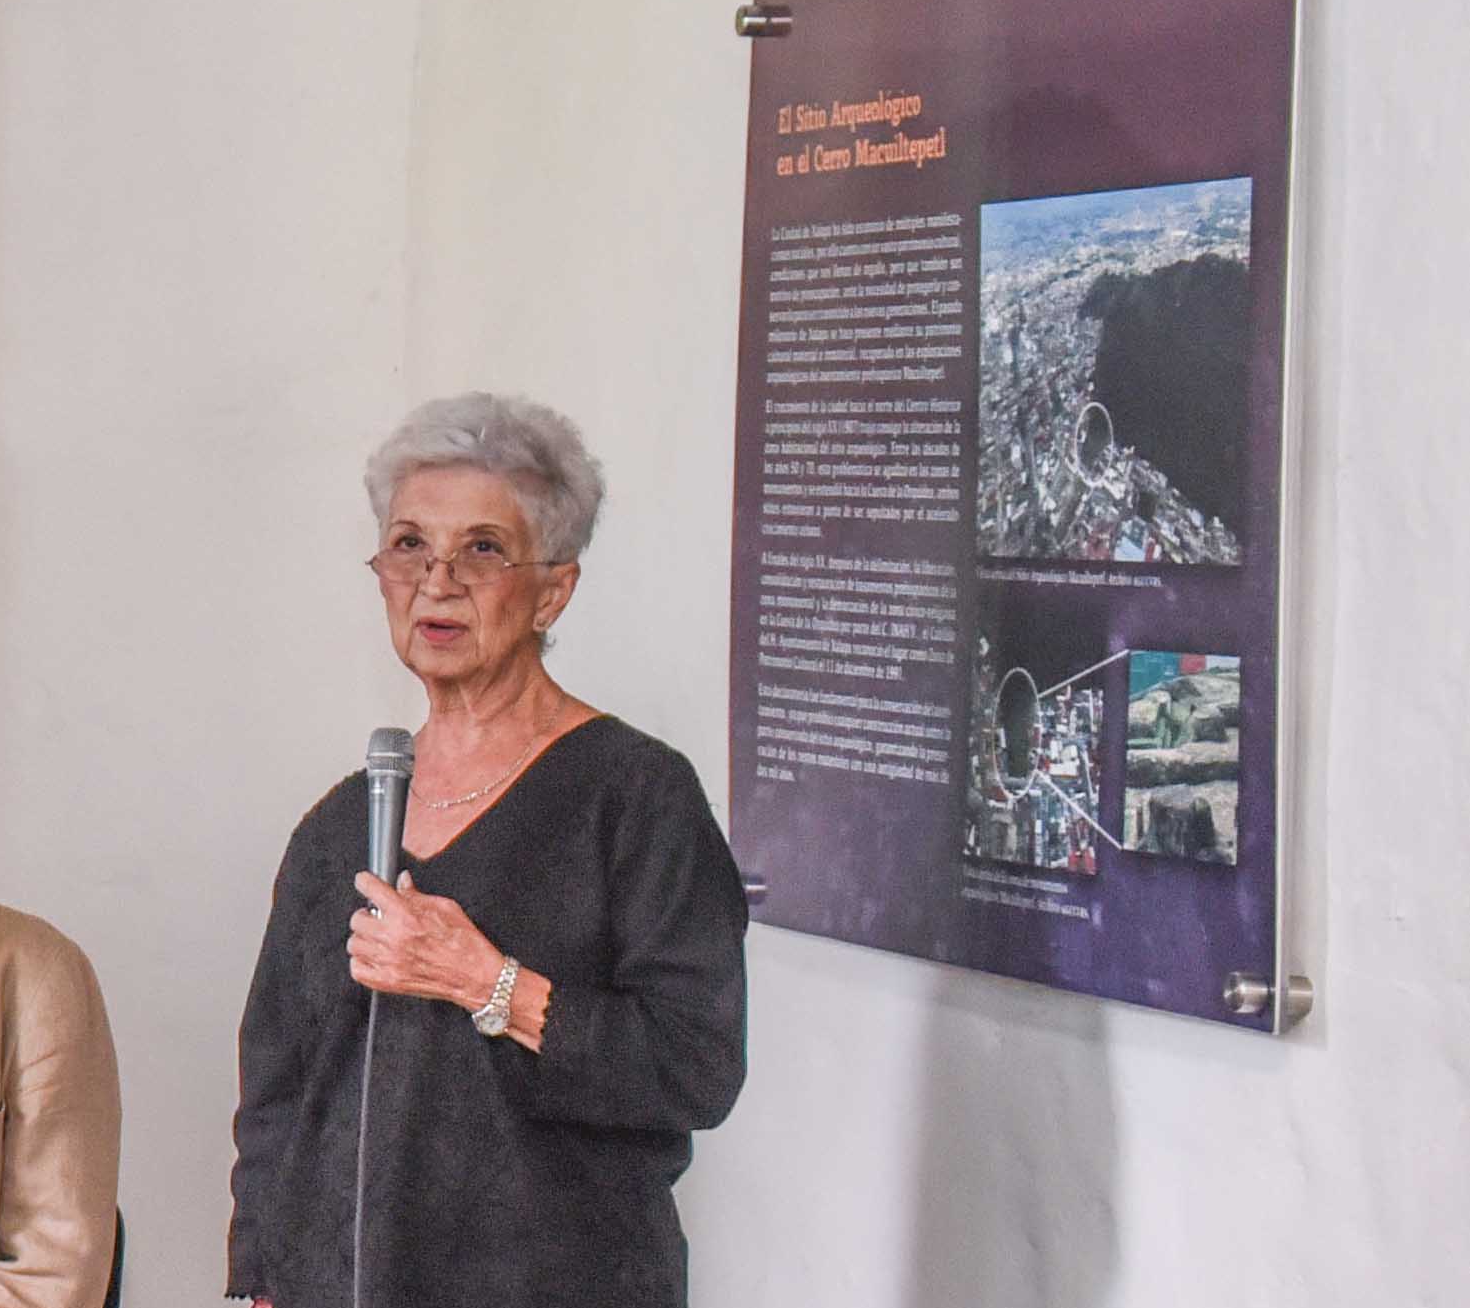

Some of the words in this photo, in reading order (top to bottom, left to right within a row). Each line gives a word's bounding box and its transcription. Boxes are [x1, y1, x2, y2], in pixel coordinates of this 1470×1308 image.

[778, 105, 792, 134] El
[796, 103, 826, 132] Sitio
[831, 90, 921, 133] Arqueológico
[777, 155, 793, 175] en
[798, 145, 809, 173] el
[814, 144, 851, 172] Cerro
[855, 126, 946, 169] Macuiltepetl
